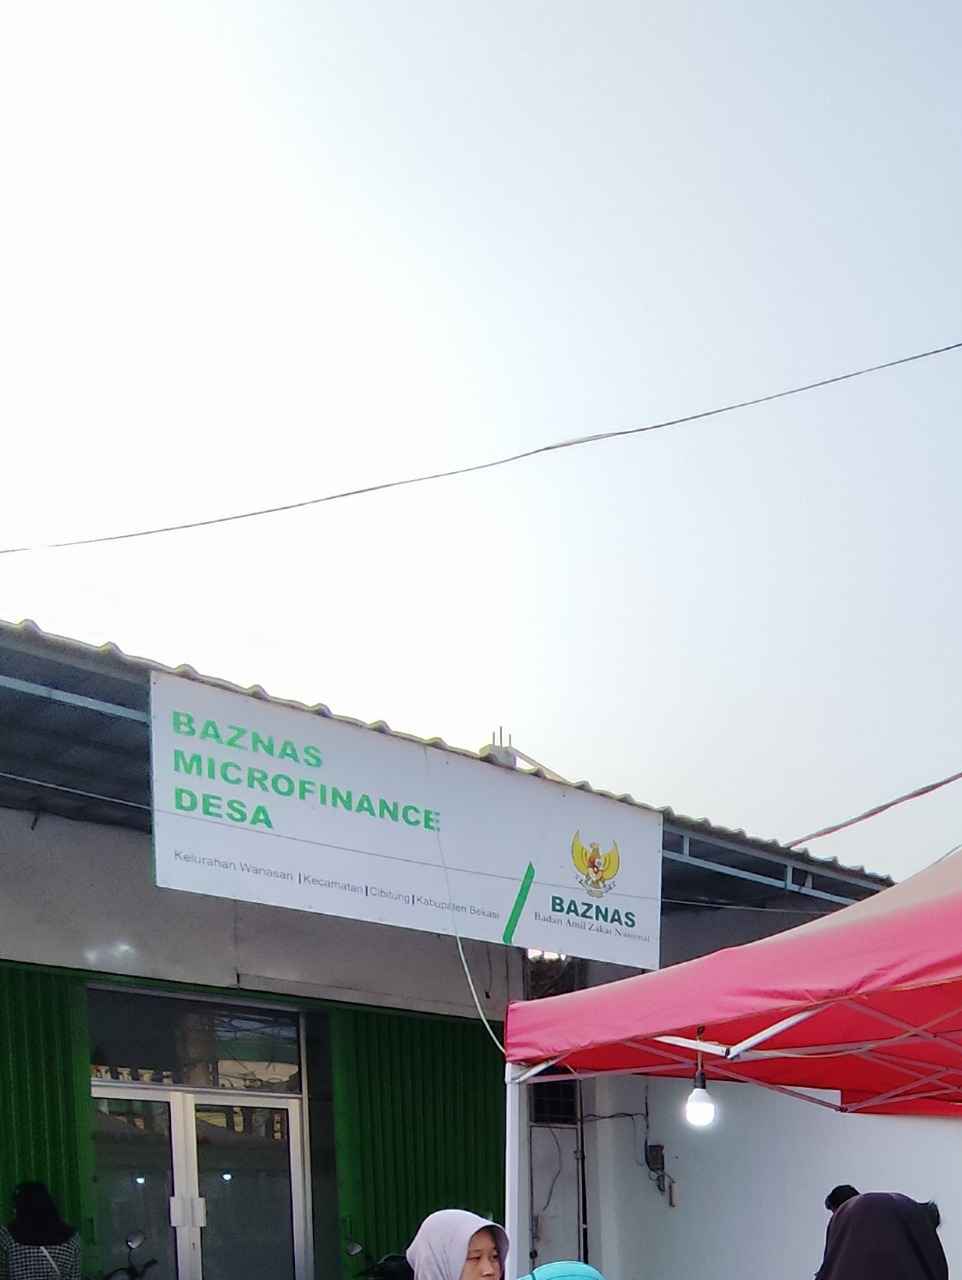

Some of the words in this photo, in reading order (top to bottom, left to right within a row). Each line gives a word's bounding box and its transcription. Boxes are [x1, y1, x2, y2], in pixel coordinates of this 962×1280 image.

[173, 711, 322, 768] BAZNAS
[174, 749, 440, 832] MICROFINANCE
[175, 788, 273, 828] DESA
[174, 850, 237, 872] Kelurahan
[551, 895, 636, 928] BAZNAS
